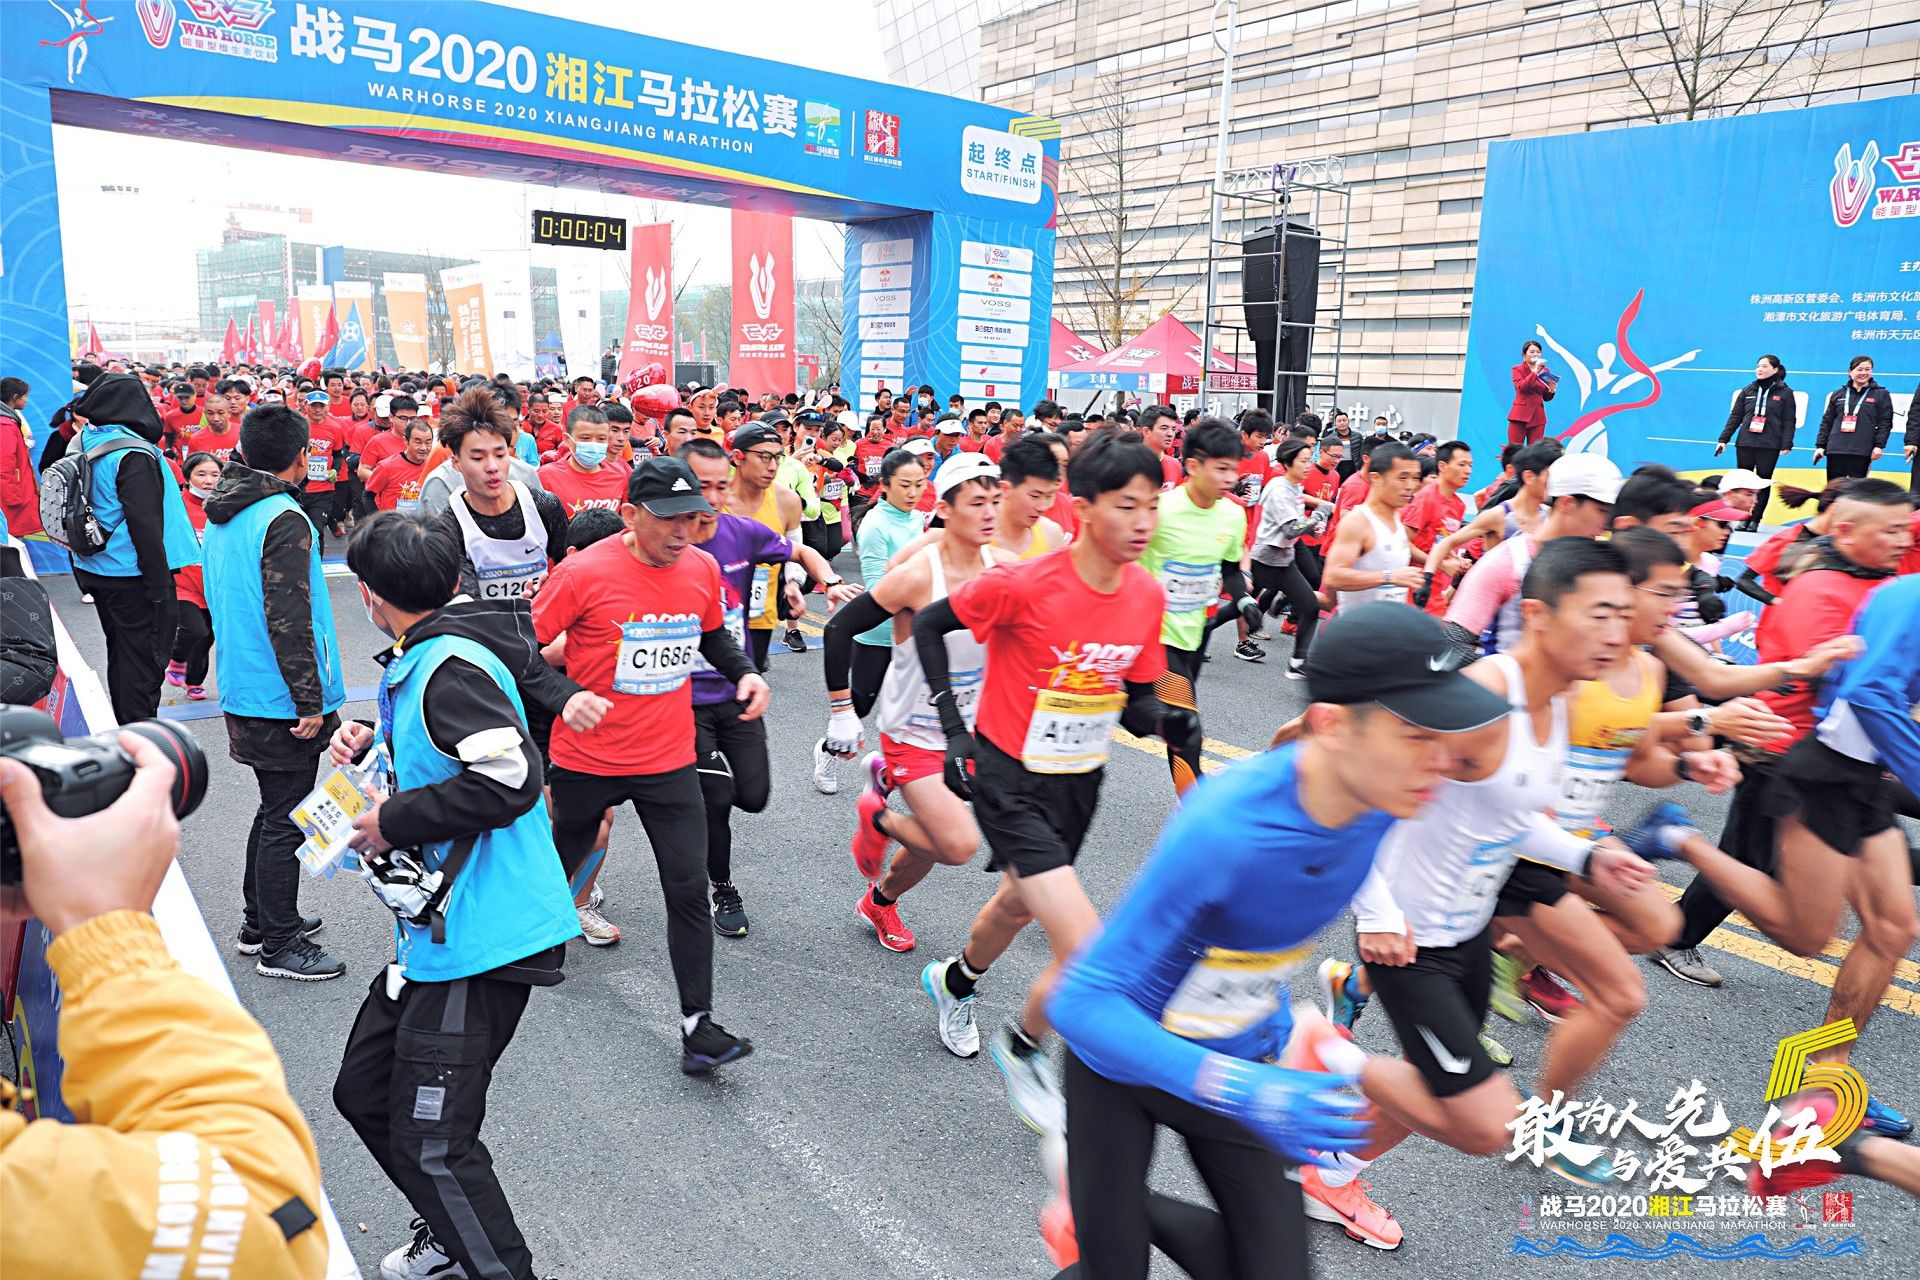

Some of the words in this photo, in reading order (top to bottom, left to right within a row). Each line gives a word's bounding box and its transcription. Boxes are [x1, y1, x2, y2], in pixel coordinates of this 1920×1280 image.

[181, 22, 218, 39] WAR
[221, 29, 276, 49] HORSE
[290, 3, 798, 138] 战马2020湘江马拉松赛
[367, 82, 487, 113] WARHORSE
[495, 102, 537, 121] 2020
[545, 110, 656, 139] XIANGJIANG
[663, 129, 753, 154] MARATHON
[968, 142, 1037, 174] 起终点
[966, 168, 1036, 189] START/FINISH
[540, 216, 621, 243] 0:00:04
[981, 298, 1012, 308] VOSS
[632, 645, 692, 669] C1686
